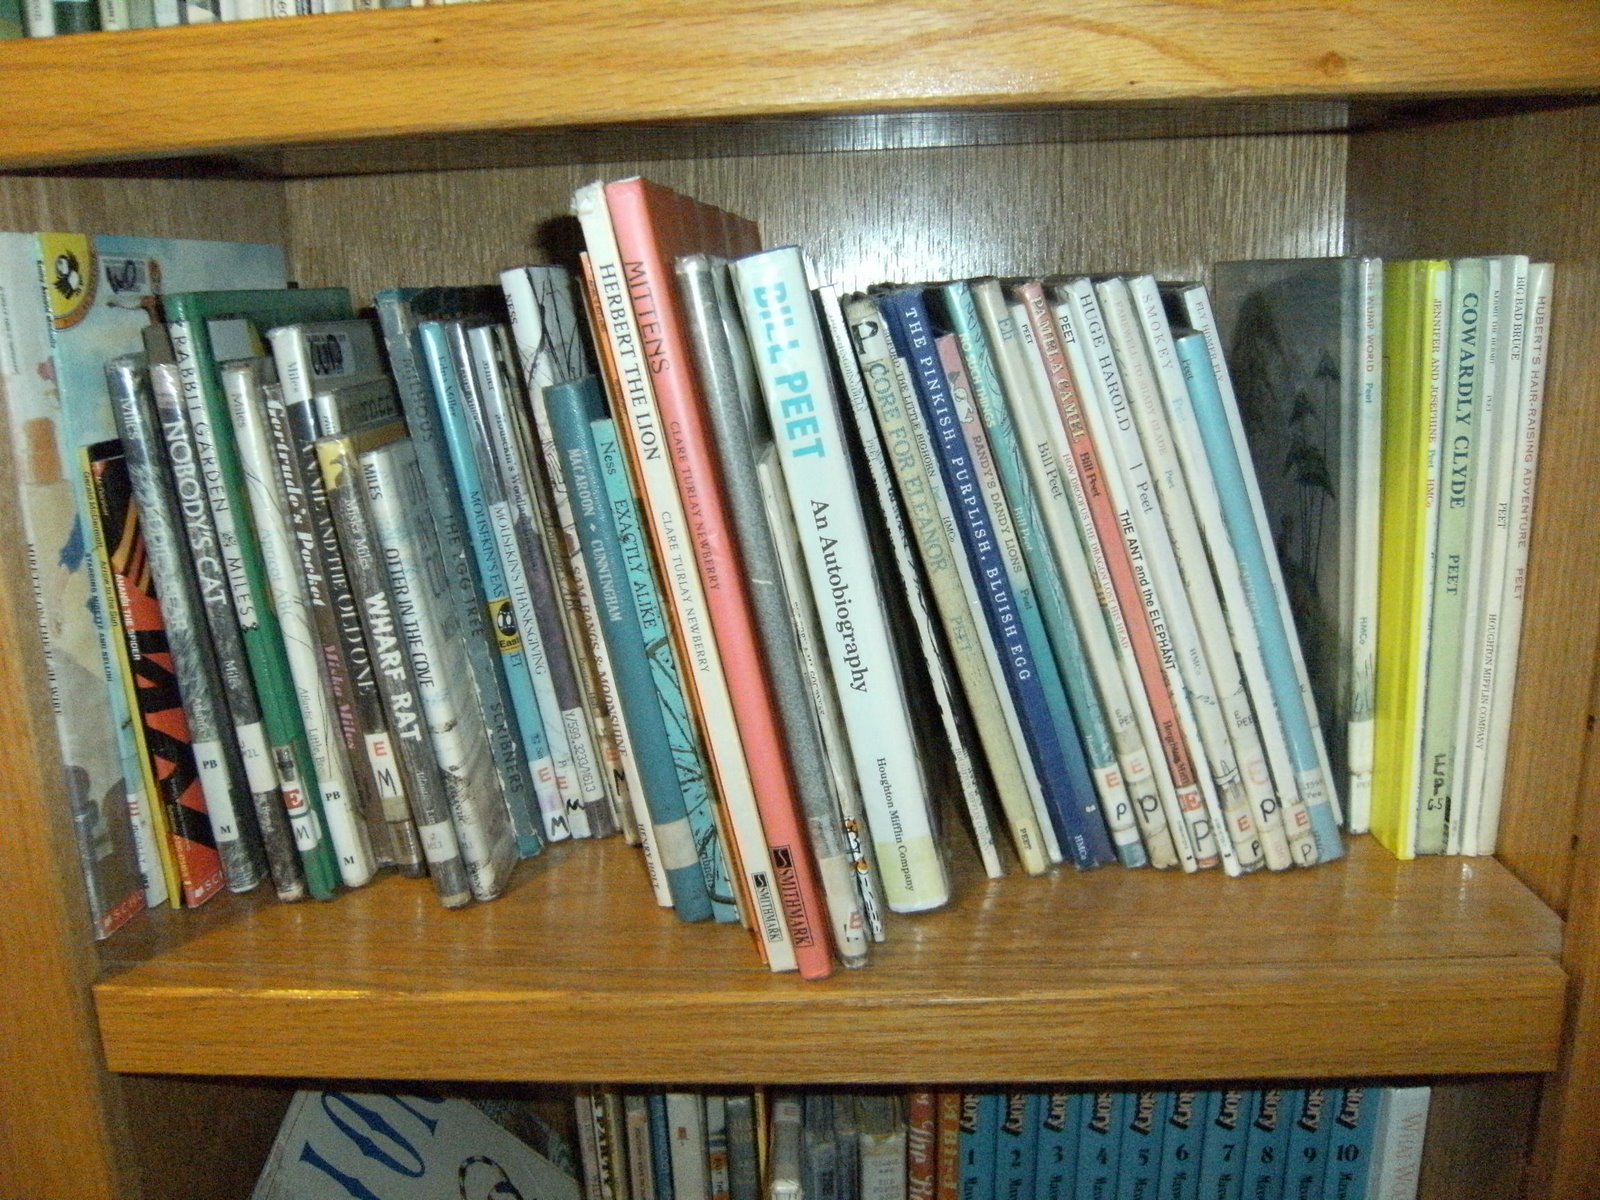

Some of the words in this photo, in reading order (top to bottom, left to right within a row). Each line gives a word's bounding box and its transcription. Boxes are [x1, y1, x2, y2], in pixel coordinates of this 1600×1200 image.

[1514, 275, 1525, 295] BIG
[751, 279, 802, 365] BILL
[1365, 295, 1377, 329] WUMP
[1431, 298, 1442, 353] JENNIFER
[1512, 298, 1523, 322] BAD
[852, 322, 878, 354] P
[958, 331, 973, 352] NO
[1020, 323, 1034, 344] PEET
[1058, 316, 1075, 344] PEET
[1142, 293, 1173, 370] SMOKEY
[1510, 323, 1521, 361] BRUCE
[1530, 295, 1545, 365] HUBERT'S
[965, 353, 983, 384] SUCH
[1365, 334, 1376, 372] WORLD
[1430, 356, 1440, 381] AND
[1456, 293, 1478, 425] COWARDLY
[1180, 357, 1196, 382] Peet
[975, 385, 996, 428] THINGS
[997, 317, 1015, 341] Eli
[1036, 441, 1053, 468] Bill
[1045, 469, 1064, 500] Peet
[1030, 296, 1065, 373] PAMELA
[1054, 378, 1085, 442] CAMEL
[1078, 450, 1094, 472] Bill
[1086, 473, 1101, 497] Peet
[1079, 294, 1106, 347] HUGE
[1098, 355, 1131, 432] HAROLD
[1136, 481, 1154, 513] Peet
[1364, 382, 1374, 403] Peet
[229, 392, 249, 428] Miles
[623, 258, 670, 374] MITTENS
[669, 421, 687, 462] CLARE
[681, 467, 701, 518] TURLAY
[694, 521, 720, 591] NEWBERRY
[773, 369, 827, 465] PEET
[895, 370, 910, 394] THE
[904, 395, 920, 430] LITTLE
[916, 432, 935, 477] BIGHORN
[1427, 384, 1439, 443] JOSEPHINE
[1524, 370, 1539, 462] HAIR-RAISING
[599, 263, 636, 359] HERBERT
[624, 364, 647, 407] THE
[636, 412, 660, 461] LION
[660, 511, 677, 551] CLARE
[672, 556, 691, 603] TURLAY
[685, 607, 709, 673] NEWBERRY
[1426, 449, 1435, 468] Peet
[1449, 436, 1469, 509] CLYDE
[174, 335, 203, 412] RABBIT
[194, 421, 227, 513] GARDEN
[227, 556, 253, 616] MILES
[361, 463, 382, 500] MILES
[1163, 469, 1177, 489] Peet
[887, 426, 916, 473] FOR
[903, 475, 948, 574] ELEANOR
[904, 307, 926, 348] THE
[919, 356, 958, 450] PINKISH,
[950, 456, 992, 561] PURPLISH,
[987, 568, 1017, 637] BLUISH
[1011, 645, 1030, 680] EGG
[1516, 467, 1532, 548] ADVENTURE
[163, 420, 212, 551] NOBODY'S
[195, 556, 226, 608] CAT
[808, 496, 834, 530] An
[971, 435, 996, 489] RANDY'S
[989, 492, 1011, 535] DANDY
[1004, 538, 1023, 573] LIONS
[1019, 588, 1034, 611] Peet
[1119, 510, 1134, 534] THE
[1496, 502, 1507, 529] PEET
[567, 447, 595, 516] MACAROON
[590, 538, 622, 622] CUNNINGHAM
[599, 441, 618, 476] Ness
[612, 499, 642, 576] EXACTLY
[633, 579, 656, 628] ALIKE
[1127, 538, 1142, 561] ANT
[265, 396, 309, 524] Gertrude's
[295, 529, 328, 608] Pocket
[323, 644, 345, 697] Miska
[337, 703, 357, 750] Miles
[326, 552, 345, 590] THE
[384, 546, 410, 596] OTTER
[1135, 564, 1150, 587] and
[1445, 553, 1459, 595] PEET
[1513, 567, 1524, 600] PEET
[494, 505, 523, 582] MOUSEKIN'S
[513, 584, 546, 675] THANKSGIVING
[1142, 587, 1158, 607] the
[121, 608, 134, 627] THE
[343, 497, 362, 534] Miska
[354, 538, 371, 570] Miles
[364, 592, 406, 682] WHARF
[389, 692, 420, 743] RAT
[399, 598, 415, 617] IN
[816, 534, 872, 695] Autobiography
[1109, 604, 1122, 622] HIS
[126, 629, 142, 661] SPIDER
[404, 621, 422, 648] THE
[1114, 621, 1130, 650] HEAD
[1149, 609, 1175, 670] ELEPHANT
[1357, 616, 1368, 645] HMCo
[1483, 613, 1496, 665] HOUGHTON
[412, 651, 433, 689] COVE
[1478, 666, 1492, 704] MIFFLIN
[1474, 705, 1488, 750] COMPANY
[372, 740, 387, 757] E
[490, 703, 524, 793] SCRIBNERS
[203, 759, 218, 770] PB
[1104, 772, 1120, 788] E
[325, 791, 341, 801] PB
[379, 768, 396, 796] M
[875, 757, 896, 808] Houghton
[1138, 795, 1157, 823] P
[1237, 814, 1250, 833] E
[1260, 798, 1275, 821] P
[1294, 810, 1309, 827] E
[220, 825, 231, 835] M
[887, 809, 904, 842] Mifflin
[1017, 827, 1032, 851] PEET
[1193, 820, 1209, 852] P
[344, 855, 355, 866] M
[894, 845, 916, 892] Company
[1300, 843, 1312, 862] P
[646, 860, 661, 891] HOLT
[755, 885, 781, 941] SMITHMARK
[776, 865, 813, 947] SMITHMARK
[968, 1149, 975, 1165] 1
[1011, 1150, 1021, 1167] 2
[1053, 1146, 1063, 1162] 3
[1097, 1147, 1107, 1164] 4
[1138, 1149, 1149, 1166] 5
[1175, 1144, 1189, 1161] 6
[1223, 1144, 1235, 1162] 7
[1261, 1145, 1273, 1163] 8
[1303, 1145, 1316, 1163] 9
[1337, 1144, 1359, 1161] 10
